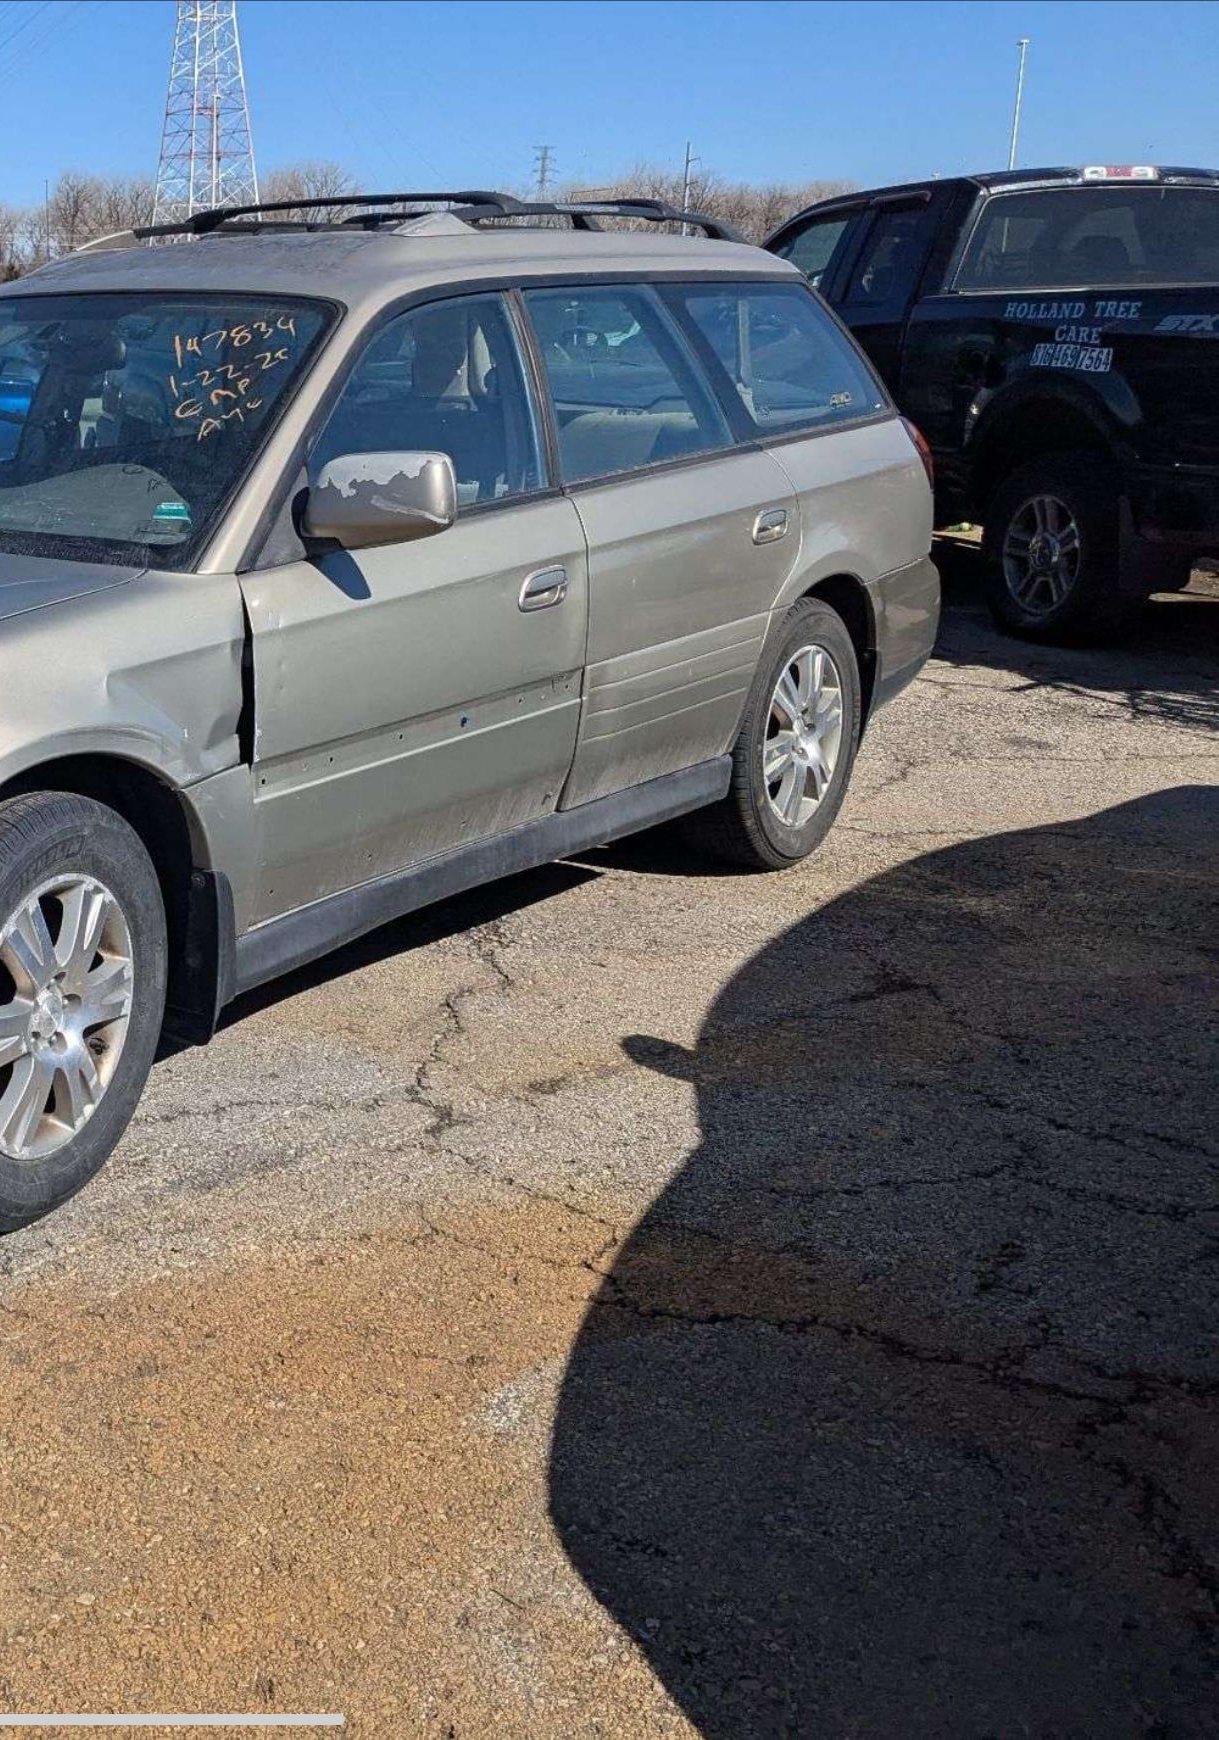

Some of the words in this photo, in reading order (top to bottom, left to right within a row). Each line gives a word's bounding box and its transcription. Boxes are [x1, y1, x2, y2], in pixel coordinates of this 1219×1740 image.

[1004, 302, 1085, 319] HOLLAND
[1094, 301, 1142, 318] TREE
[174, 316, 296, 368] 147834
[1054, 324, 1102, 344] CARE
